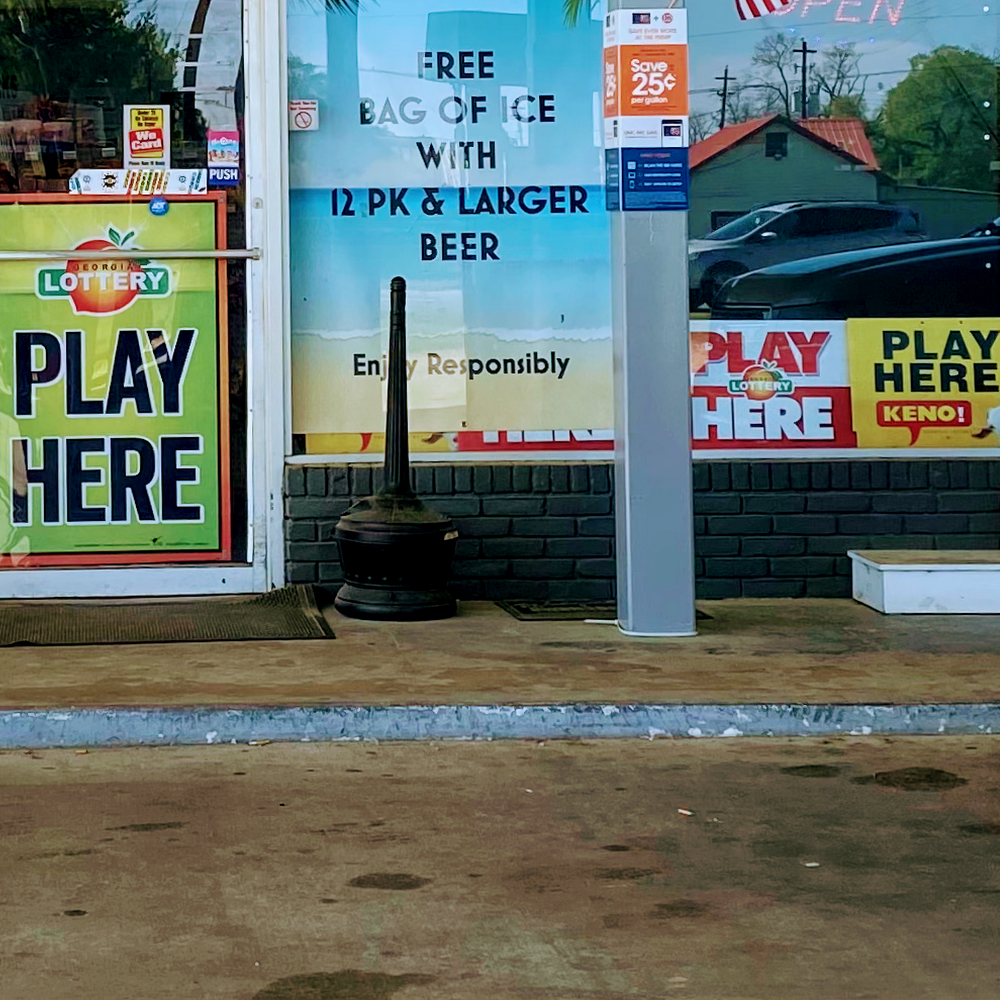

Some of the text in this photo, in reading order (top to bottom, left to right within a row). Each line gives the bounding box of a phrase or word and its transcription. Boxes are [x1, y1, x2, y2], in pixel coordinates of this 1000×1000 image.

[418, 51, 494, 79] FREE
[631, 59, 668, 72] Save
[631, 72, 676, 96] 25¢
[359, 95, 555, 125] BAG OF ICE
[631, 97, 668, 105] per gallon
[131, 138, 162, 150] Card
[135, 131, 157, 140] We
[416, 141, 496, 169] WITH
[209, 169, 238, 180] PUSH
[331, 186, 589, 216] 12 PK & LARGER
[421, 233, 500, 261] BEER
[74, 263, 134, 271] GEORGIA
[44, 271, 166, 292] LOTTERY
[690, 331, 834, 376] PLAY
[882, 330, 1000, 360] PLAY
[15, 330, 195, 416] PLAY
[353, 351, 570, 381] Enjy Responsibly
[874, 363, 1000, 393] HERE
[731, 381, 790, 391] LOTTERY
[692, 397, 835, 440] HERE
[883, 405, 965, 423] KENO!
[12, 437, 200, 523] HERE
